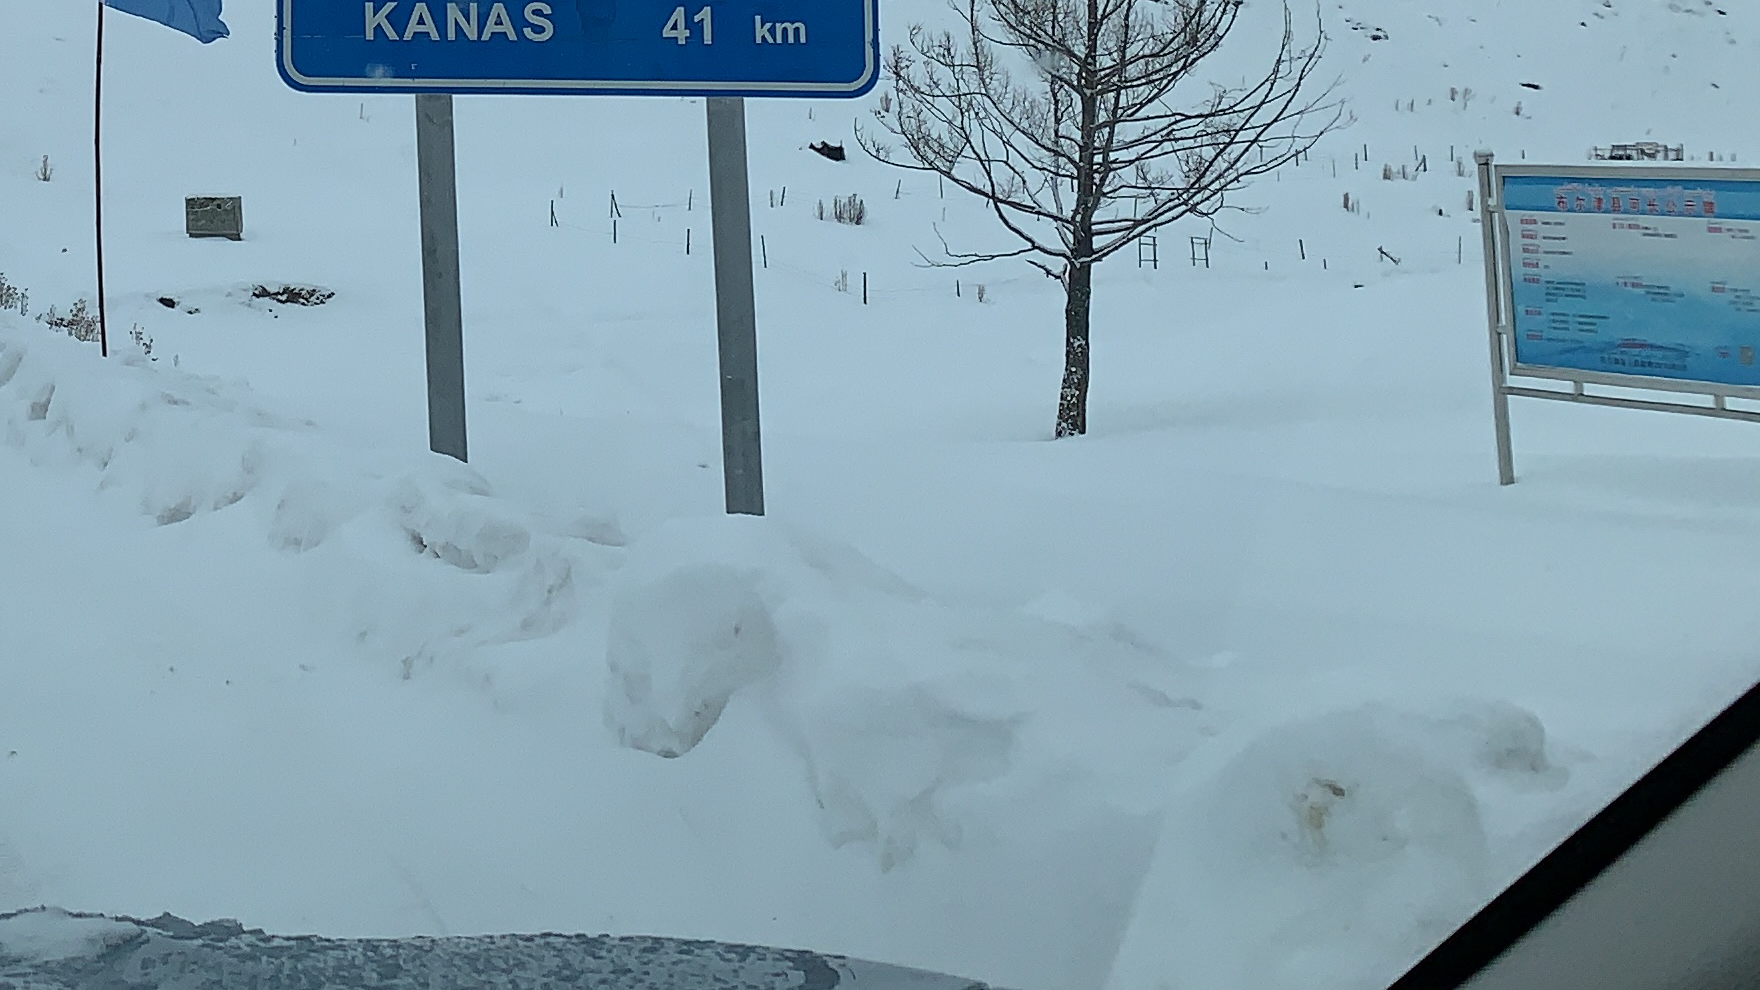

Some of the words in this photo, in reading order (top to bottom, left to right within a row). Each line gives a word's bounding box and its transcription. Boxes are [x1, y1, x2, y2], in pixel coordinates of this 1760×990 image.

[364, 1, 554, 42] KANAS
[662, 6, 712, 45] 41
[754, 15, 806, 44] km
